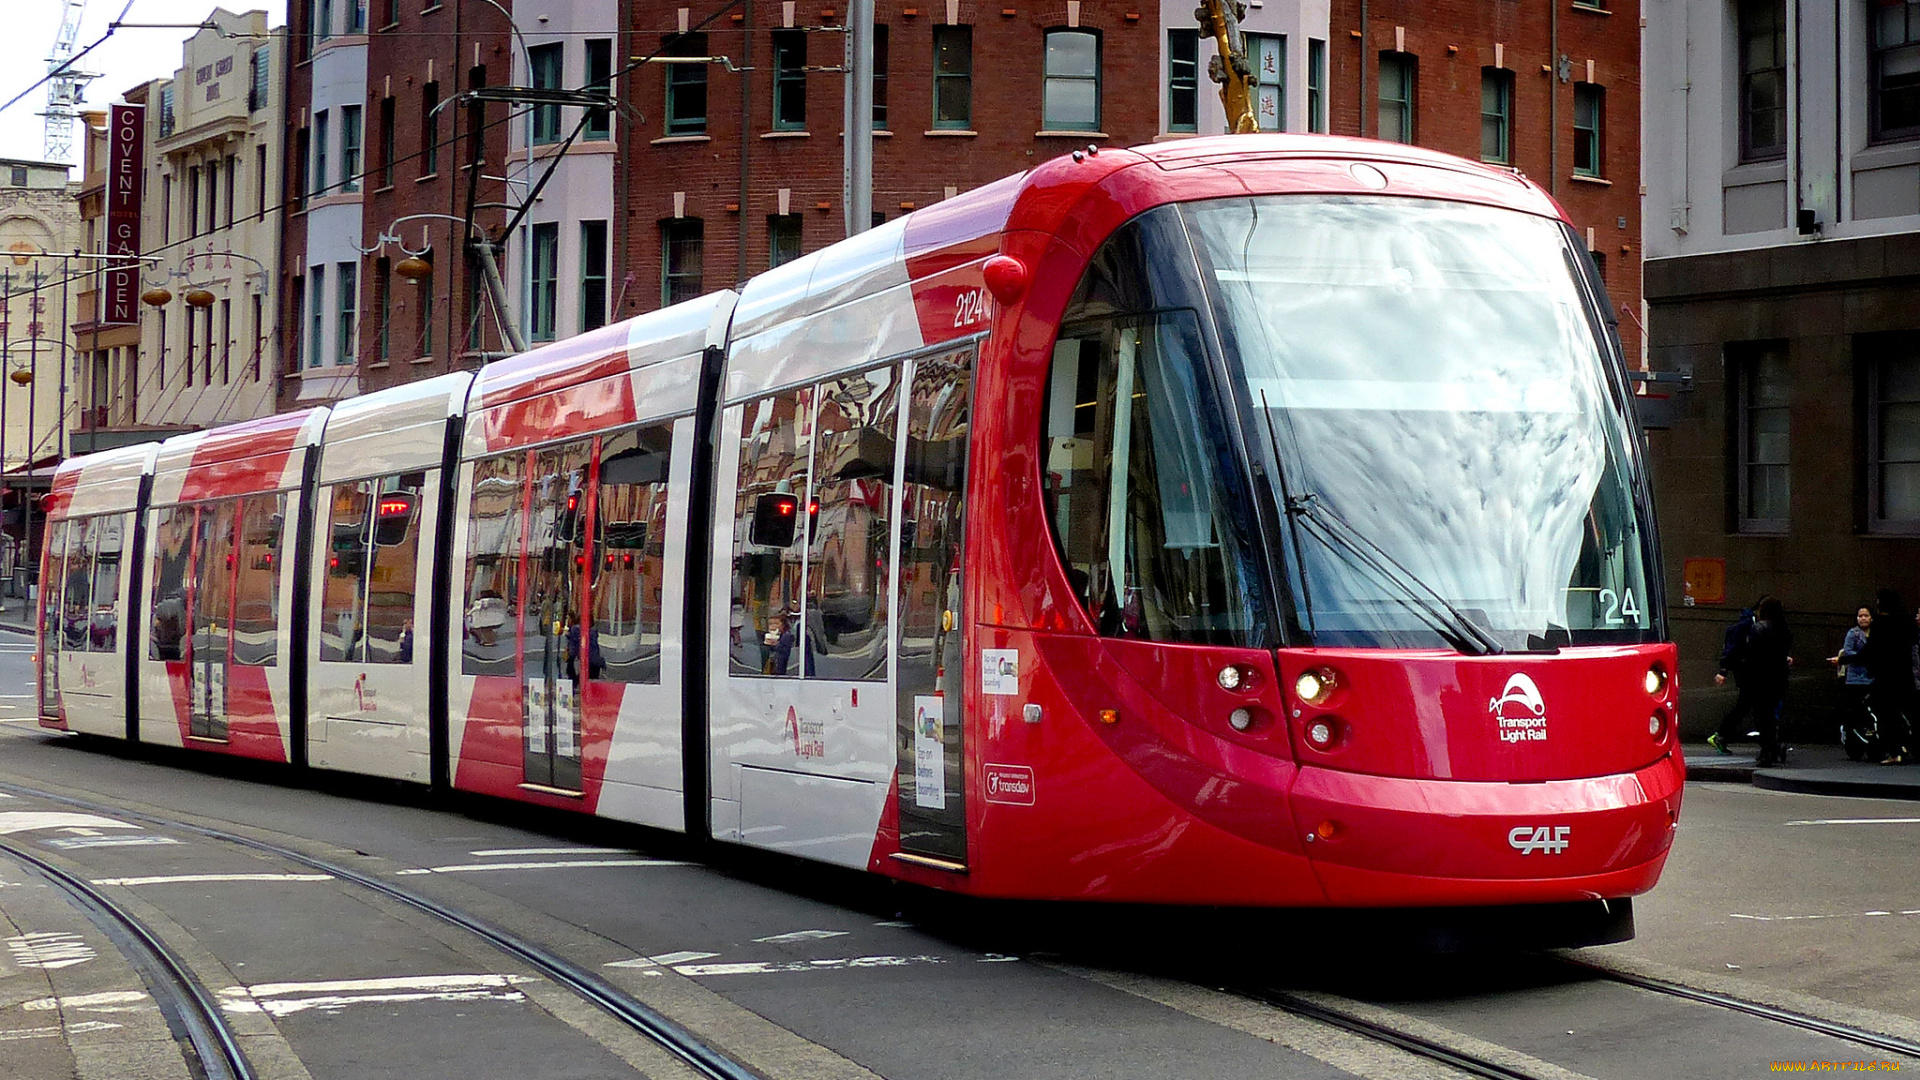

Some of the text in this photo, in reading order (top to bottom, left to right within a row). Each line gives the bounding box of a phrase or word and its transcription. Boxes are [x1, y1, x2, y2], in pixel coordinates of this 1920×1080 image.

[120, 110, 135, 206] COVENT
[954, 288, 983, 328] 2124
[1599, 587, 1640, 624] 24
[799, 717, 824, 738] Transport
[1496, 715, 1547, 729] Transport
[1500, 729, 1547, 744] Light Rail
[800, 739, 824, 760] Light Rail
[917, 782, 939, 800] boarding
[998, 779, 1029, 793] transdev
[1508, 826, 1571, 855] CAF
